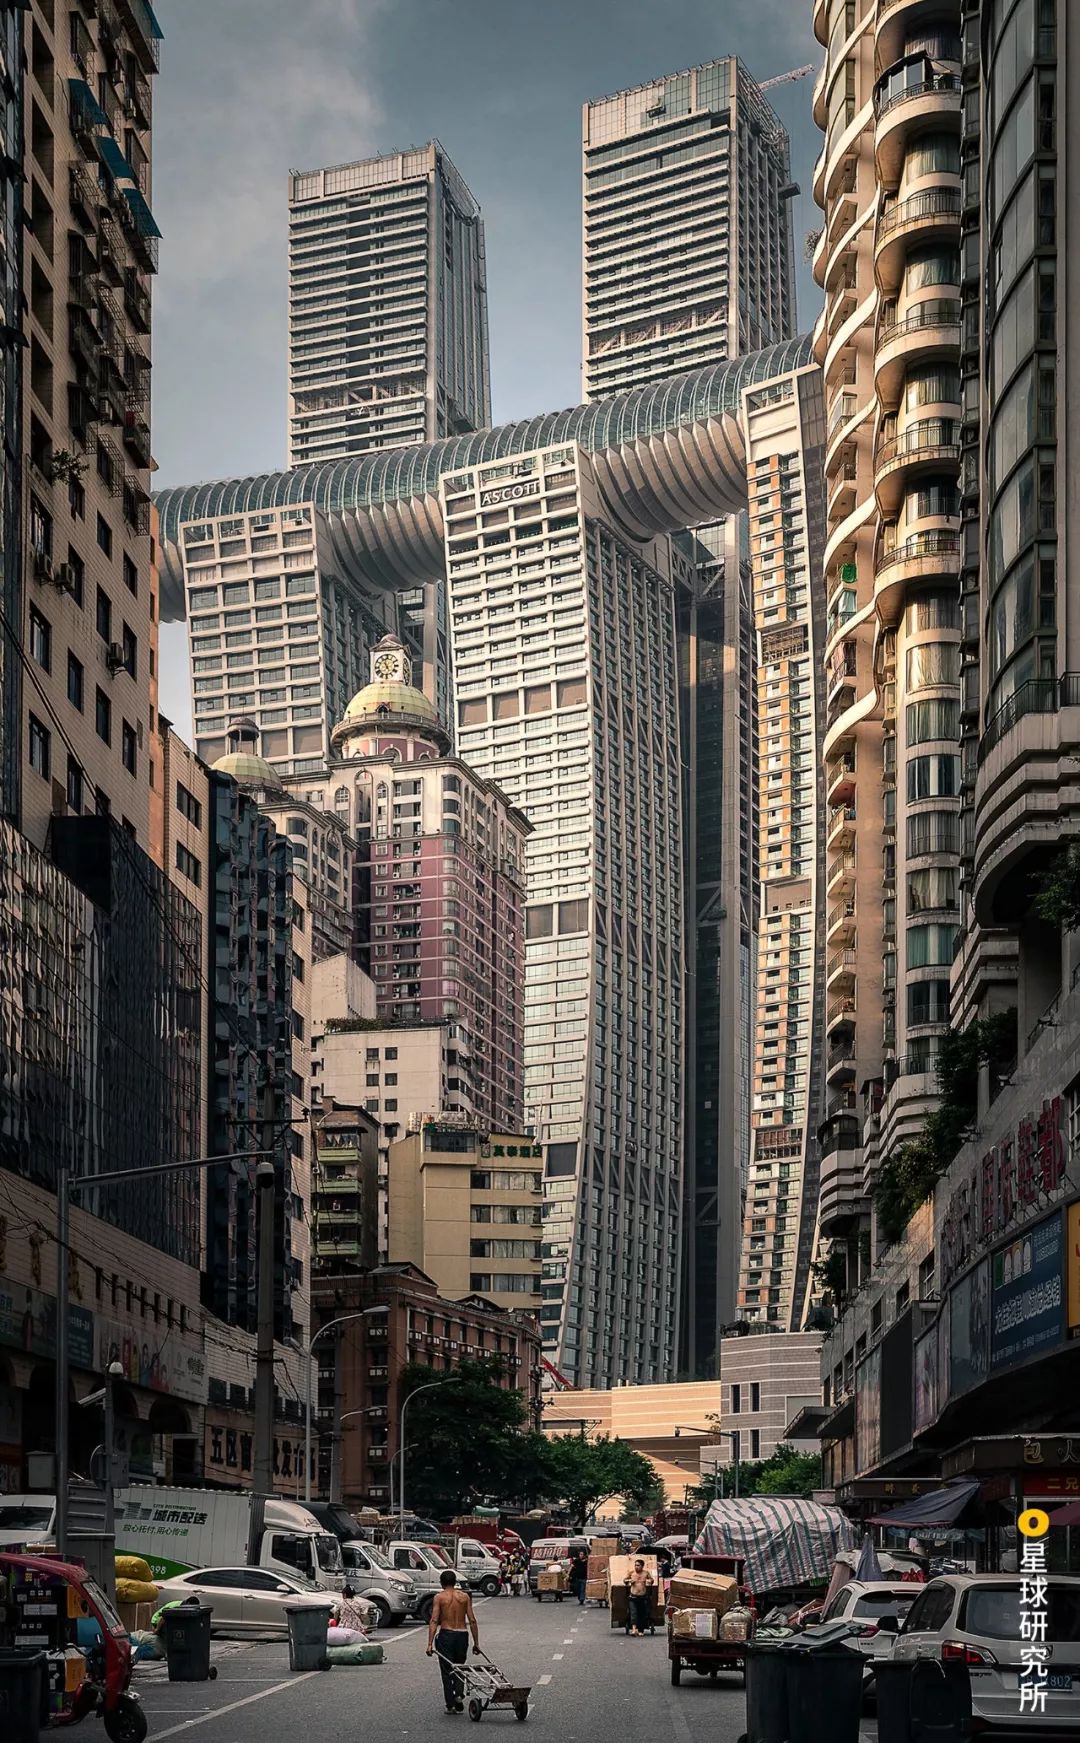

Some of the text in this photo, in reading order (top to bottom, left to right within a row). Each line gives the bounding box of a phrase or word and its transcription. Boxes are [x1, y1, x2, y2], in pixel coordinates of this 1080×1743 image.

[481, 480, 540, 506] ASCOTT
[152, 1509, 208, 1525] 城市配送
